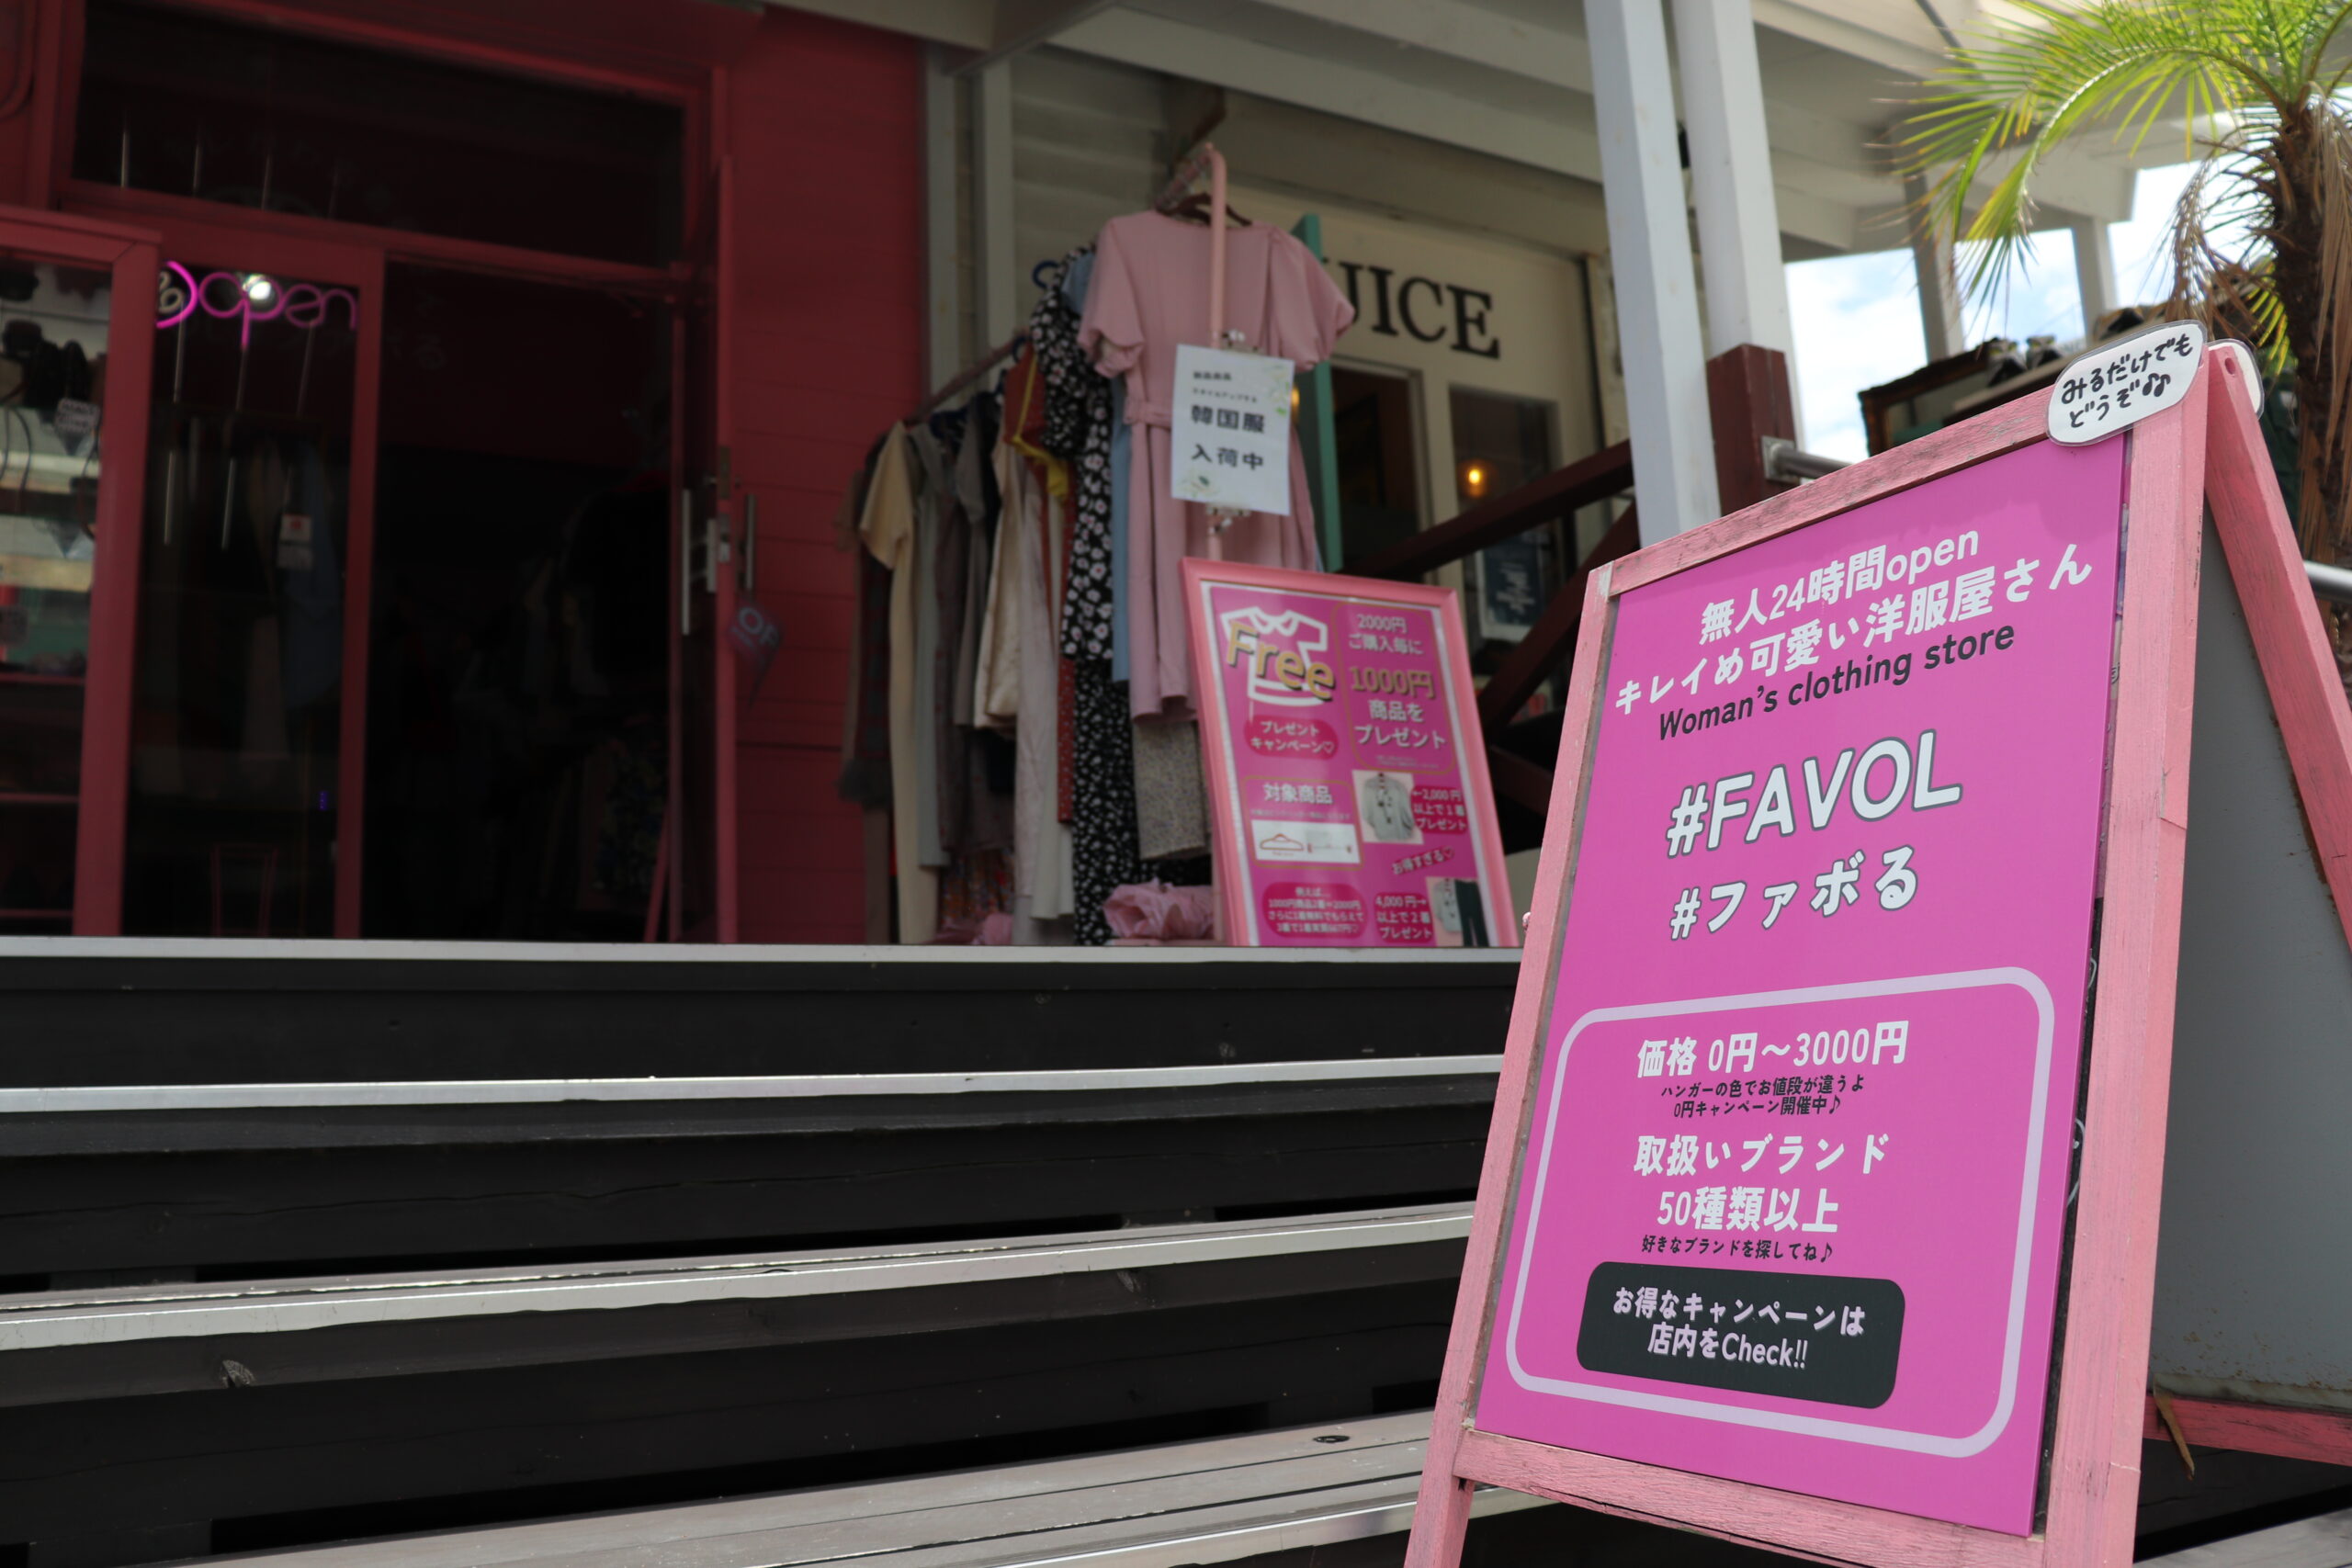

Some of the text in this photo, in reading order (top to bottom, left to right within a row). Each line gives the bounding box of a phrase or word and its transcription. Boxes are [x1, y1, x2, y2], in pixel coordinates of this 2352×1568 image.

[198, 271, 358, 350] open
[2062, 333, 2193, 404] みるだけでも
[1192, 404, 1264, 434] 韓国服
[1192, 444, 1264, 470] 入荷中
[1357, 614, 1407, 633] 2000円
[1615, 543, 2093, 715] キレイめ可愛い洋服屋さん
[1227, 621, 1336, 702] Free
[1349, 666, 1435, 698] 1000円
[1788, 652, 1911, 705] clothing
[1924, 625, 2015, 669] store
[1260, 720, 1319, 736] プレゼント
[1368, 700, 1425, 722] 商品を
[1353, 724, 1447, 750] プレゼント
[1263, 783, 1333, 805] 対象商品
[1666, 728, 1962, 858] #FAVOL
[1416, 817, 1467, 831] プレゼント
[1669, 844, 1918, 941] #ファボる
[1380, 926, 1433, 941] プレゼント
[1637, 1036, 1697, 1078] 価格
[1661, 1074, 1864, 1098] ハンガーの色でお値段が違うよ
[1634, 1133, 1889, 1177] 取扱いブランド
[1657, 1186, 1838, 1233] 50種類以上
[1613, 1286, 1866, 1337] お得なキャンペーンは
[1647, 1321, 1809, 1370] 店内をCheck!!
